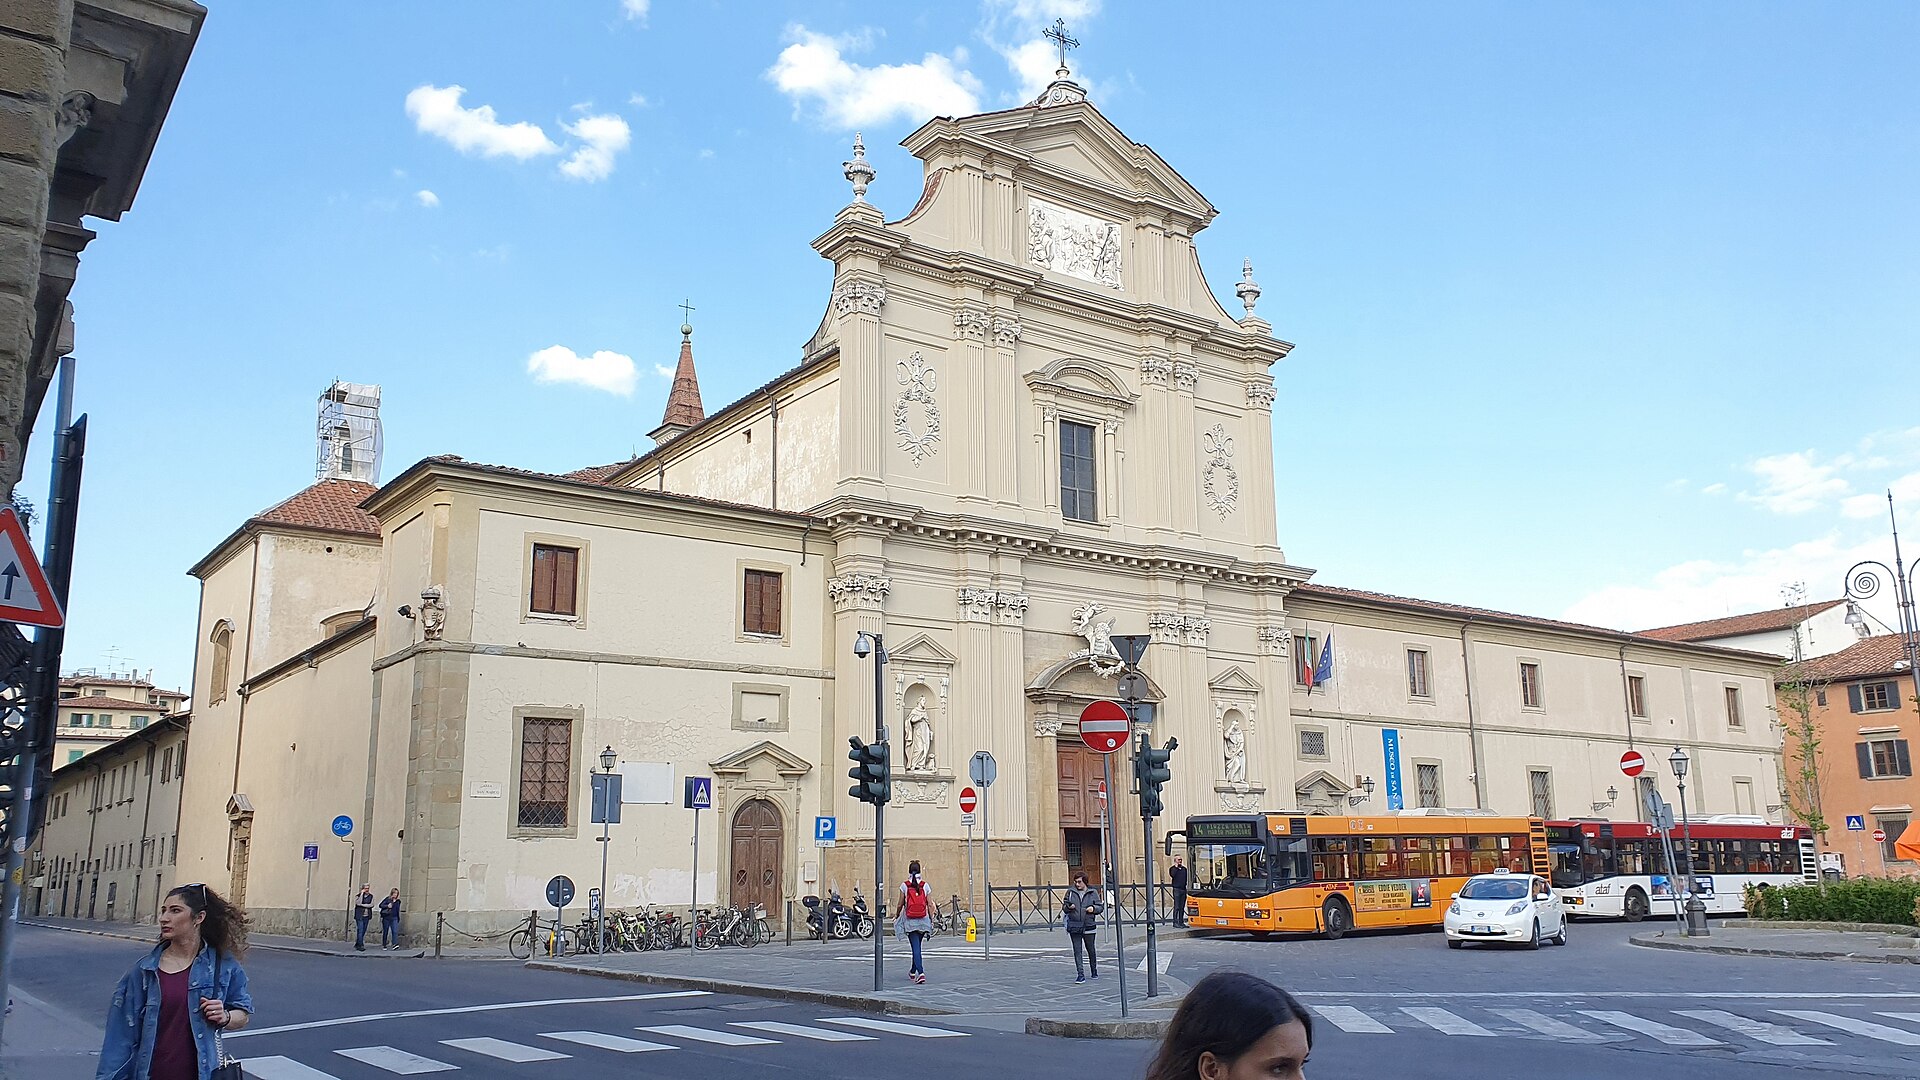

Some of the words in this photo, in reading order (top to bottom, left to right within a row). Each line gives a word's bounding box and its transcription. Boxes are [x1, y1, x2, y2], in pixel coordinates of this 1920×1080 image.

[1390, 780, 1398, 799] SAN
[819, 818, 832, 838] P
[1193, 824, 1203, 836] 14
[1780, 827, 1795, 839] ataf
[1595, 883, 1612, 895] ataf
